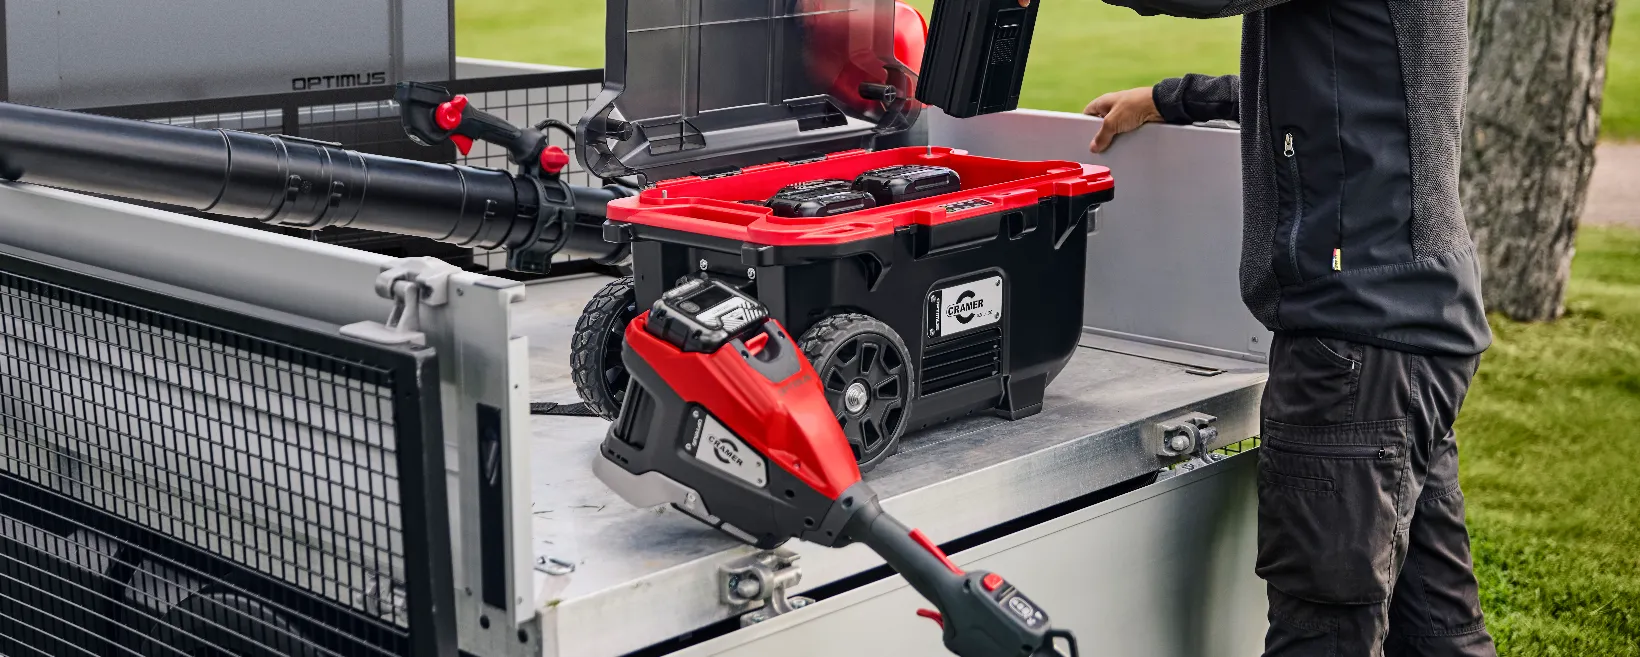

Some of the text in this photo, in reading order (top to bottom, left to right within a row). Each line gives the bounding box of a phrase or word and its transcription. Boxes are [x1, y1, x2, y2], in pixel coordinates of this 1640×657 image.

[291, 71, 386, 91] OPTIMUS
[947, 299, 984, 316] CRAMER
[707, 434, 744, 467] CRAMER
